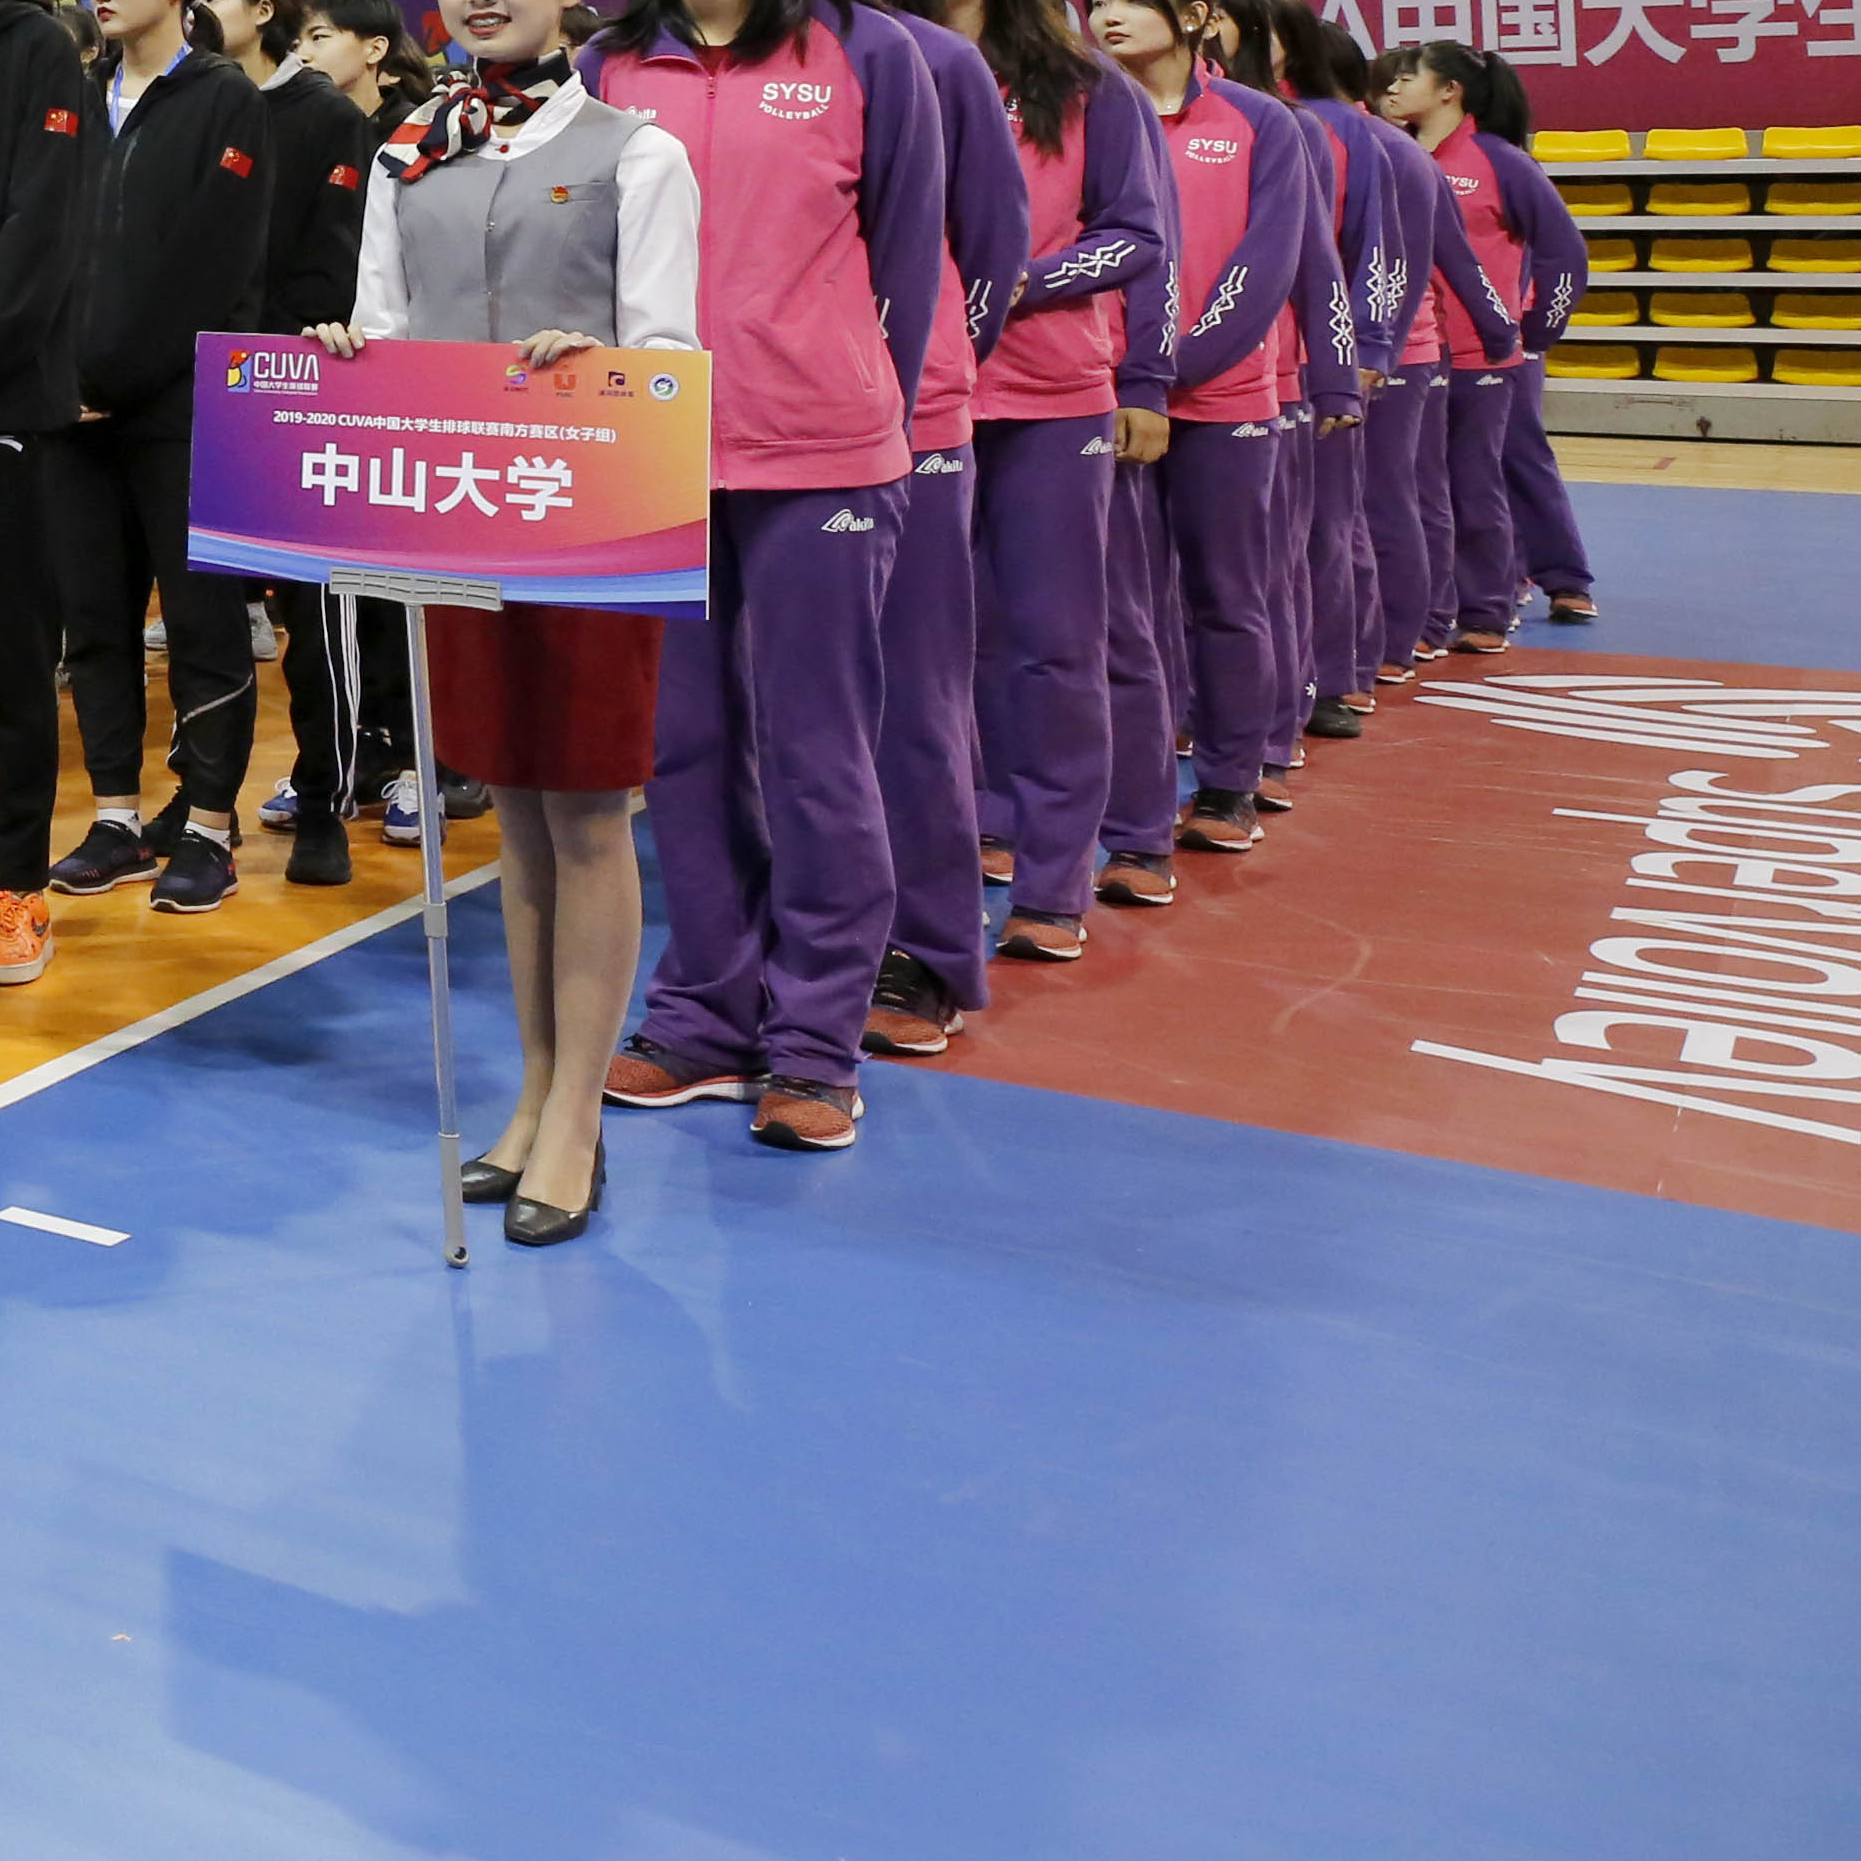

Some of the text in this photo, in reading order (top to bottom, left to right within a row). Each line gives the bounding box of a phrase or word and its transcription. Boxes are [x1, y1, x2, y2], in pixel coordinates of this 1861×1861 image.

[762, 82, 832, 103] SYSU
[759, 101, 830, 120] VOLLEYBALL
[1188, 138, 1238, 155] SYSU
[254, 351, 319, 381] CUVA
[273, 411, 337, 426] 2019-2020
[300, 442, 574, 523] 中山大学
